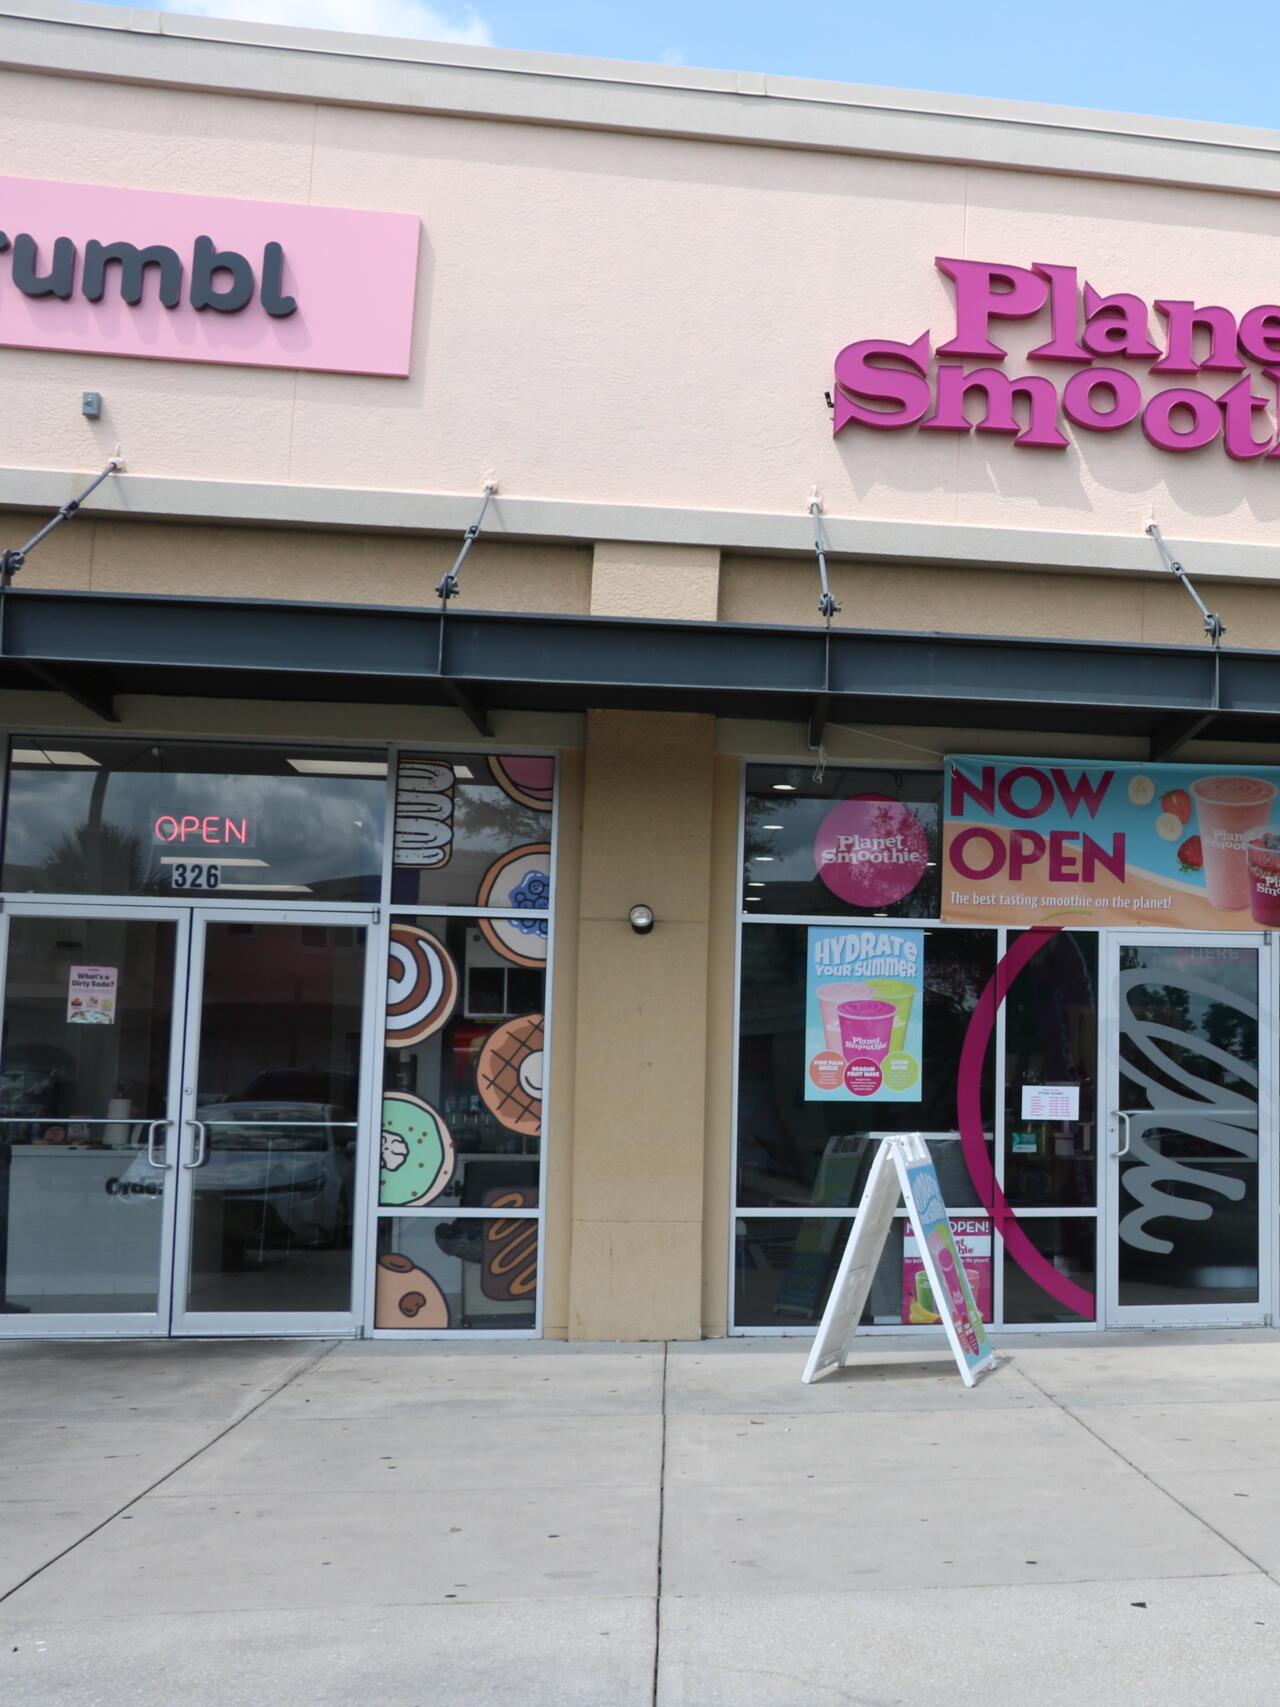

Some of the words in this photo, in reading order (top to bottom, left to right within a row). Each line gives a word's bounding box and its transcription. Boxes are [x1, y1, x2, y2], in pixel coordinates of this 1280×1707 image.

[951, 766, 1115, 819] NOW
[155, 815, 247, 844] OPEN
[837, 834, 904, 851] Planet
[821, 847, 921, 865] Smoothie
[949, 827, 1126, 884] OPEN
[174, 863, 219, 889] 326
[949, 891, 969, 905] The
[972, 892, 996, 905] best
[999, 893, 1038, 909] tasting
[1041, 894, 1092, 908] smoothie
[1095, 897, 1109, 907] on
[1112, 895, 1130, 908] the
[1132, 896, 1173, 911] planet!
[816, 964, 852, 977] YOUR
